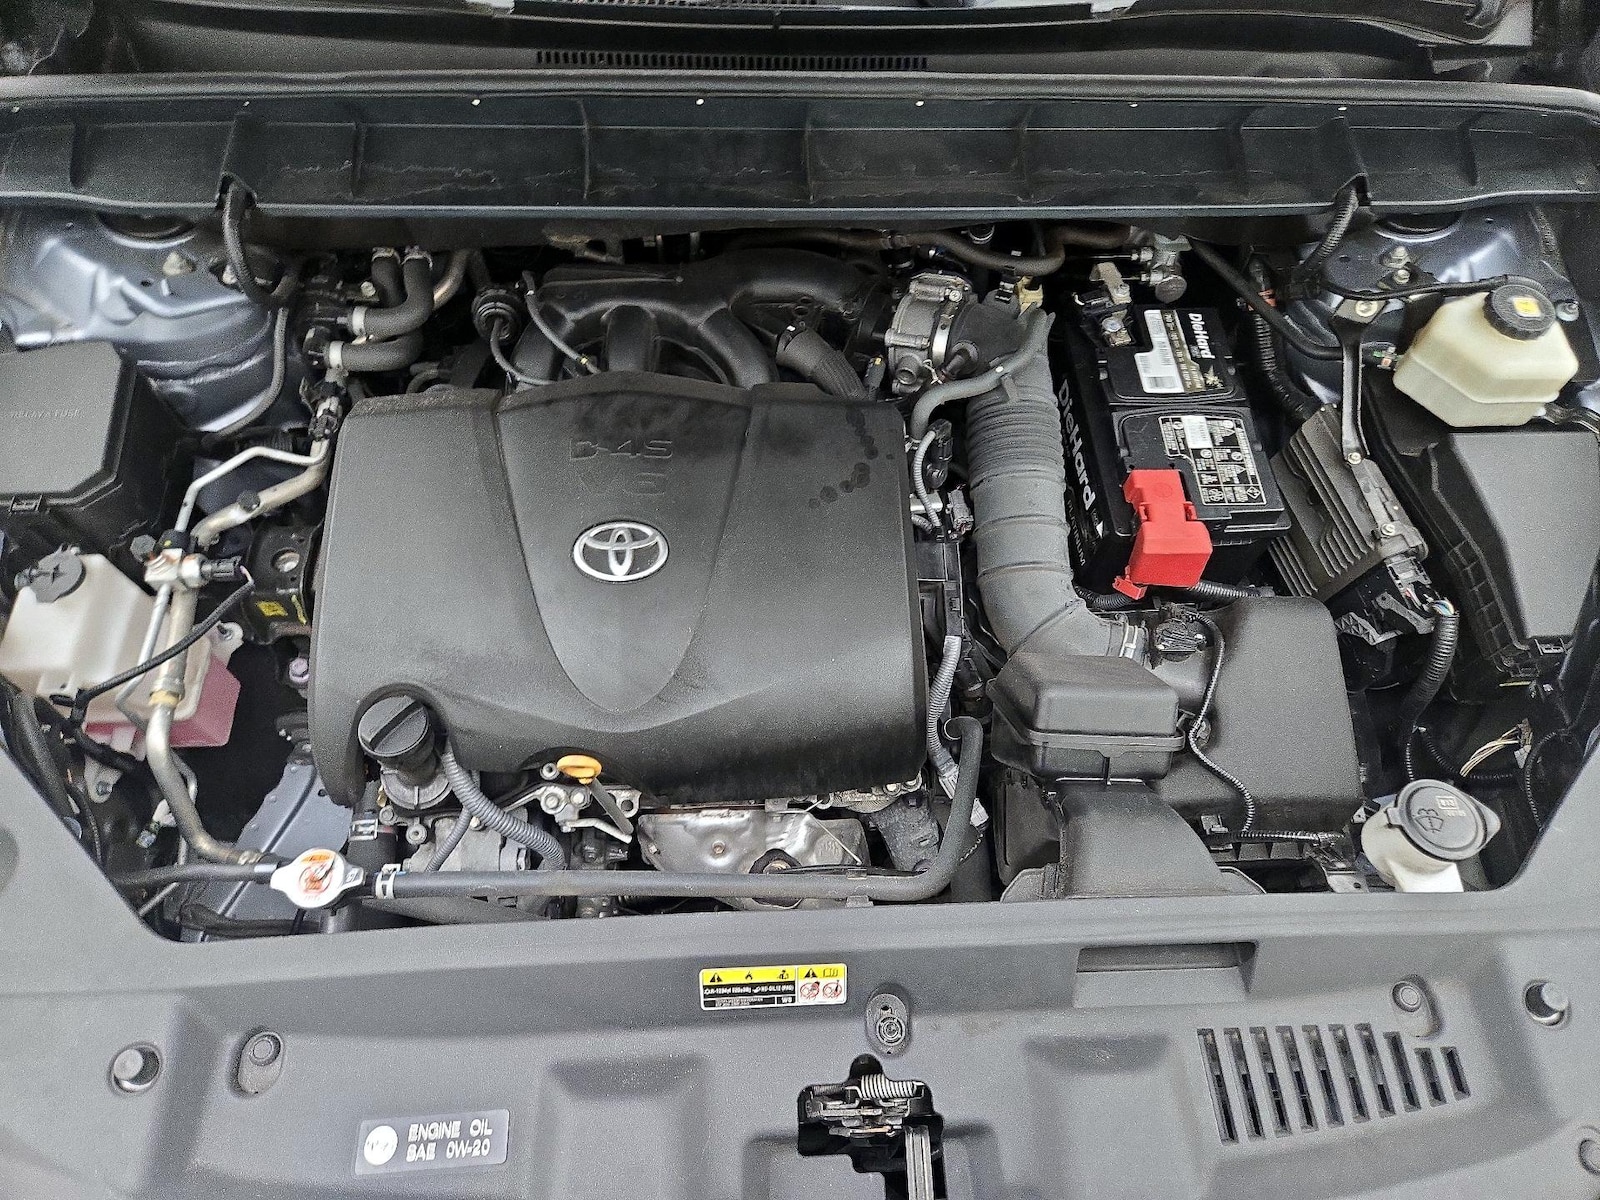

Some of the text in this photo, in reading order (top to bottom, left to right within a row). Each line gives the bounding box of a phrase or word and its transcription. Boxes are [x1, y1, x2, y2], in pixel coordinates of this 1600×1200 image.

[1188, 313, 1216, 359] DieHard
[569, 439, 674, 460] D-4S
[1058, 379, 1096, 511] DieHard
[1067, 499, 1086, 567] PLATINUM
[407, 1118, 493, 1142] ENGINE OIL
[405, 1138, 491, 1163] SAE 0W-20
